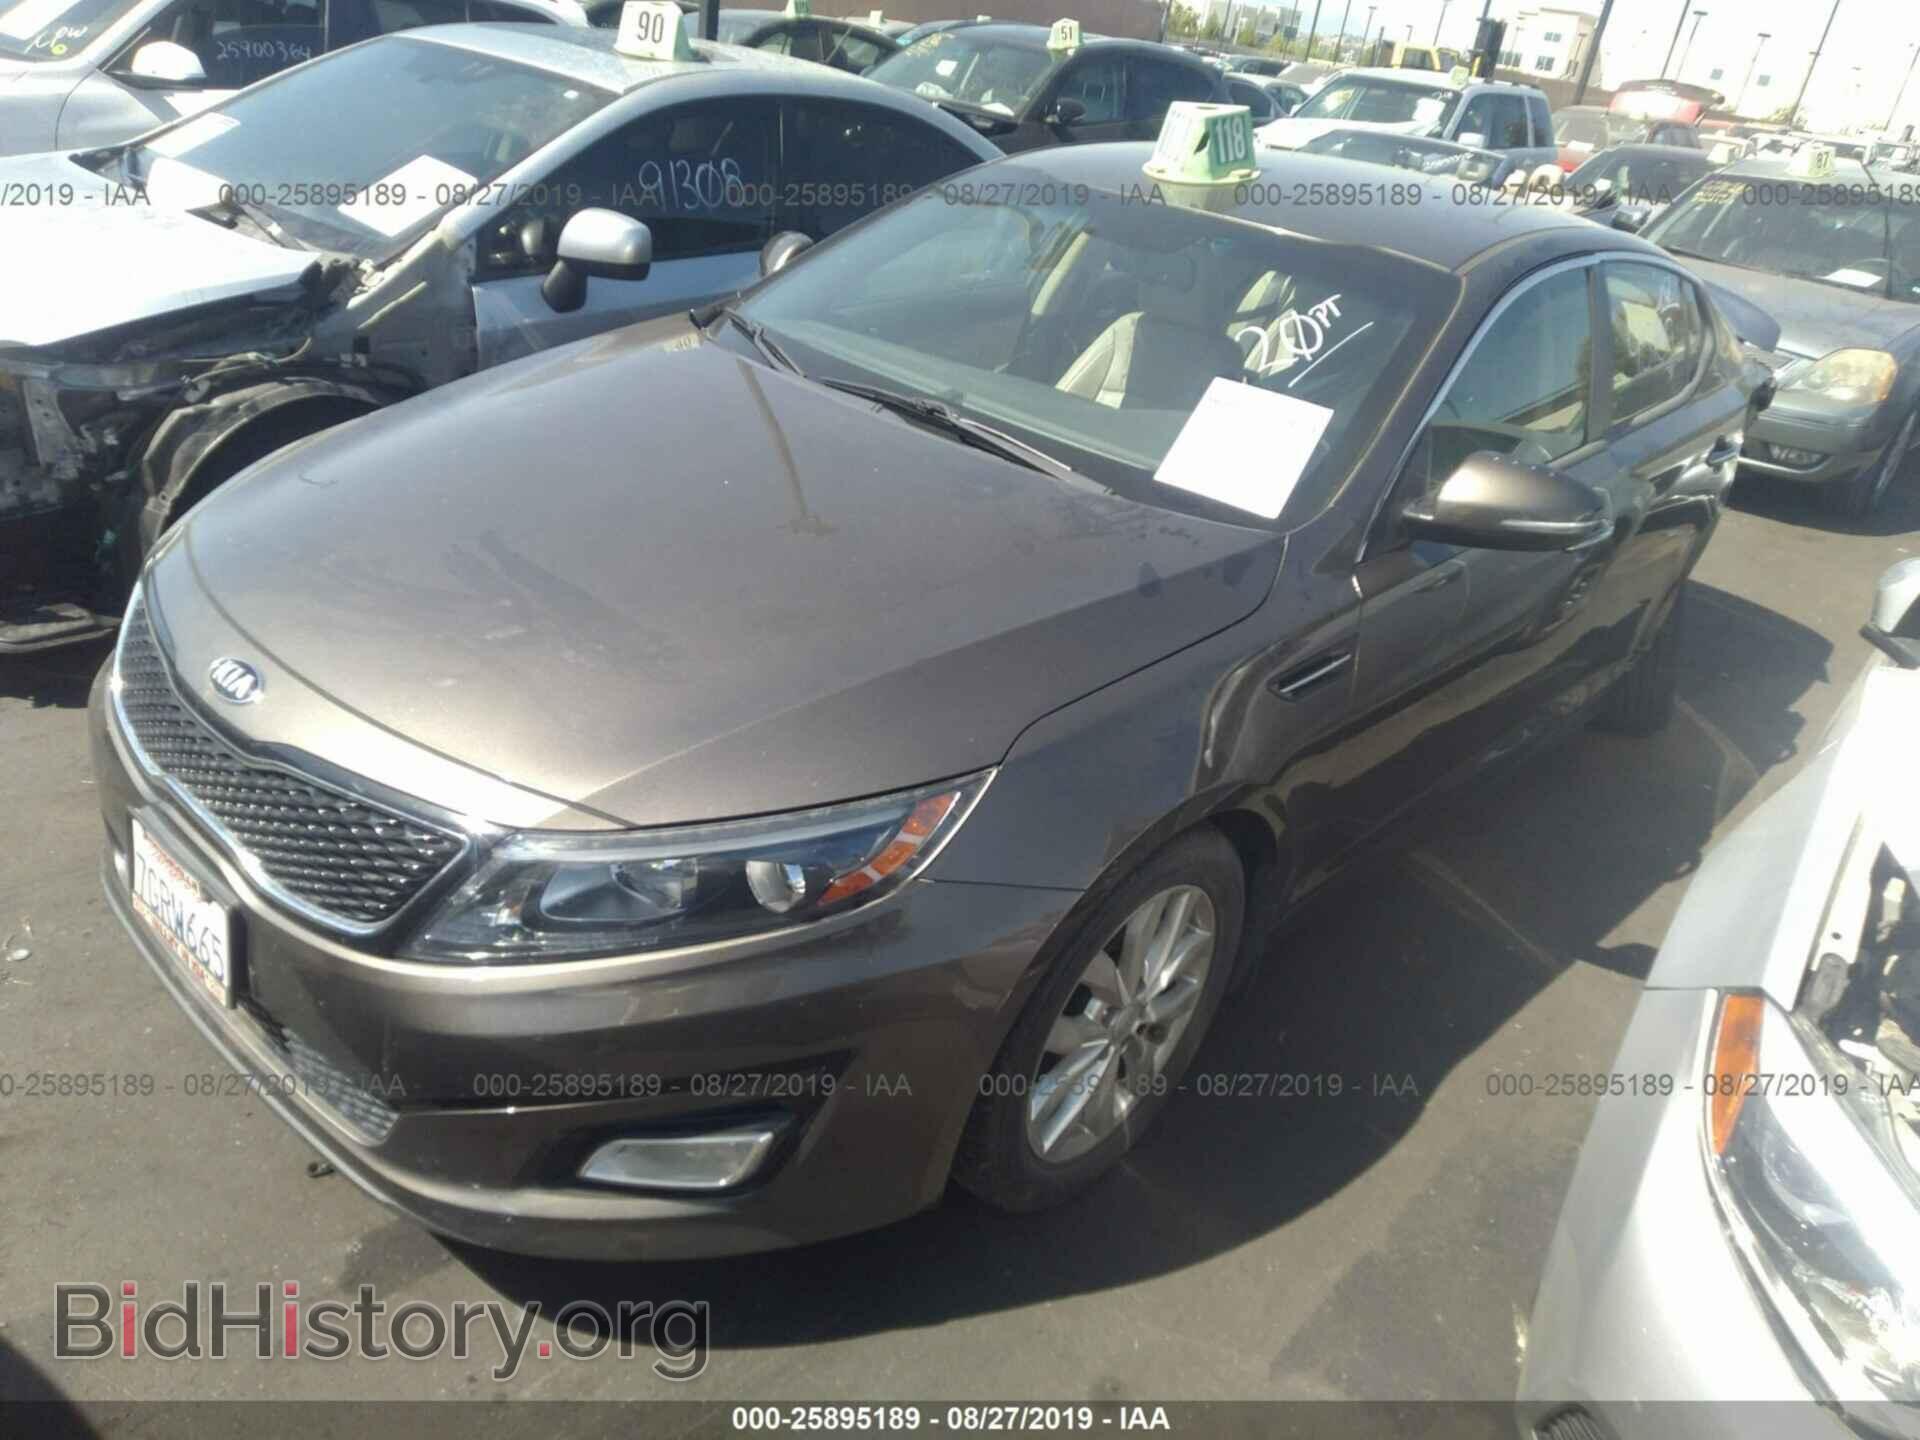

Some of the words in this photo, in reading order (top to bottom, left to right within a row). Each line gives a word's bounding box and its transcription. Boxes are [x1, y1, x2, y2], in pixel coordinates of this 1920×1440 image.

[636, 10, 665, 44] 90
[1060, 25, 1073, 41] 51
[1215, 114, 1247, 164] 118
